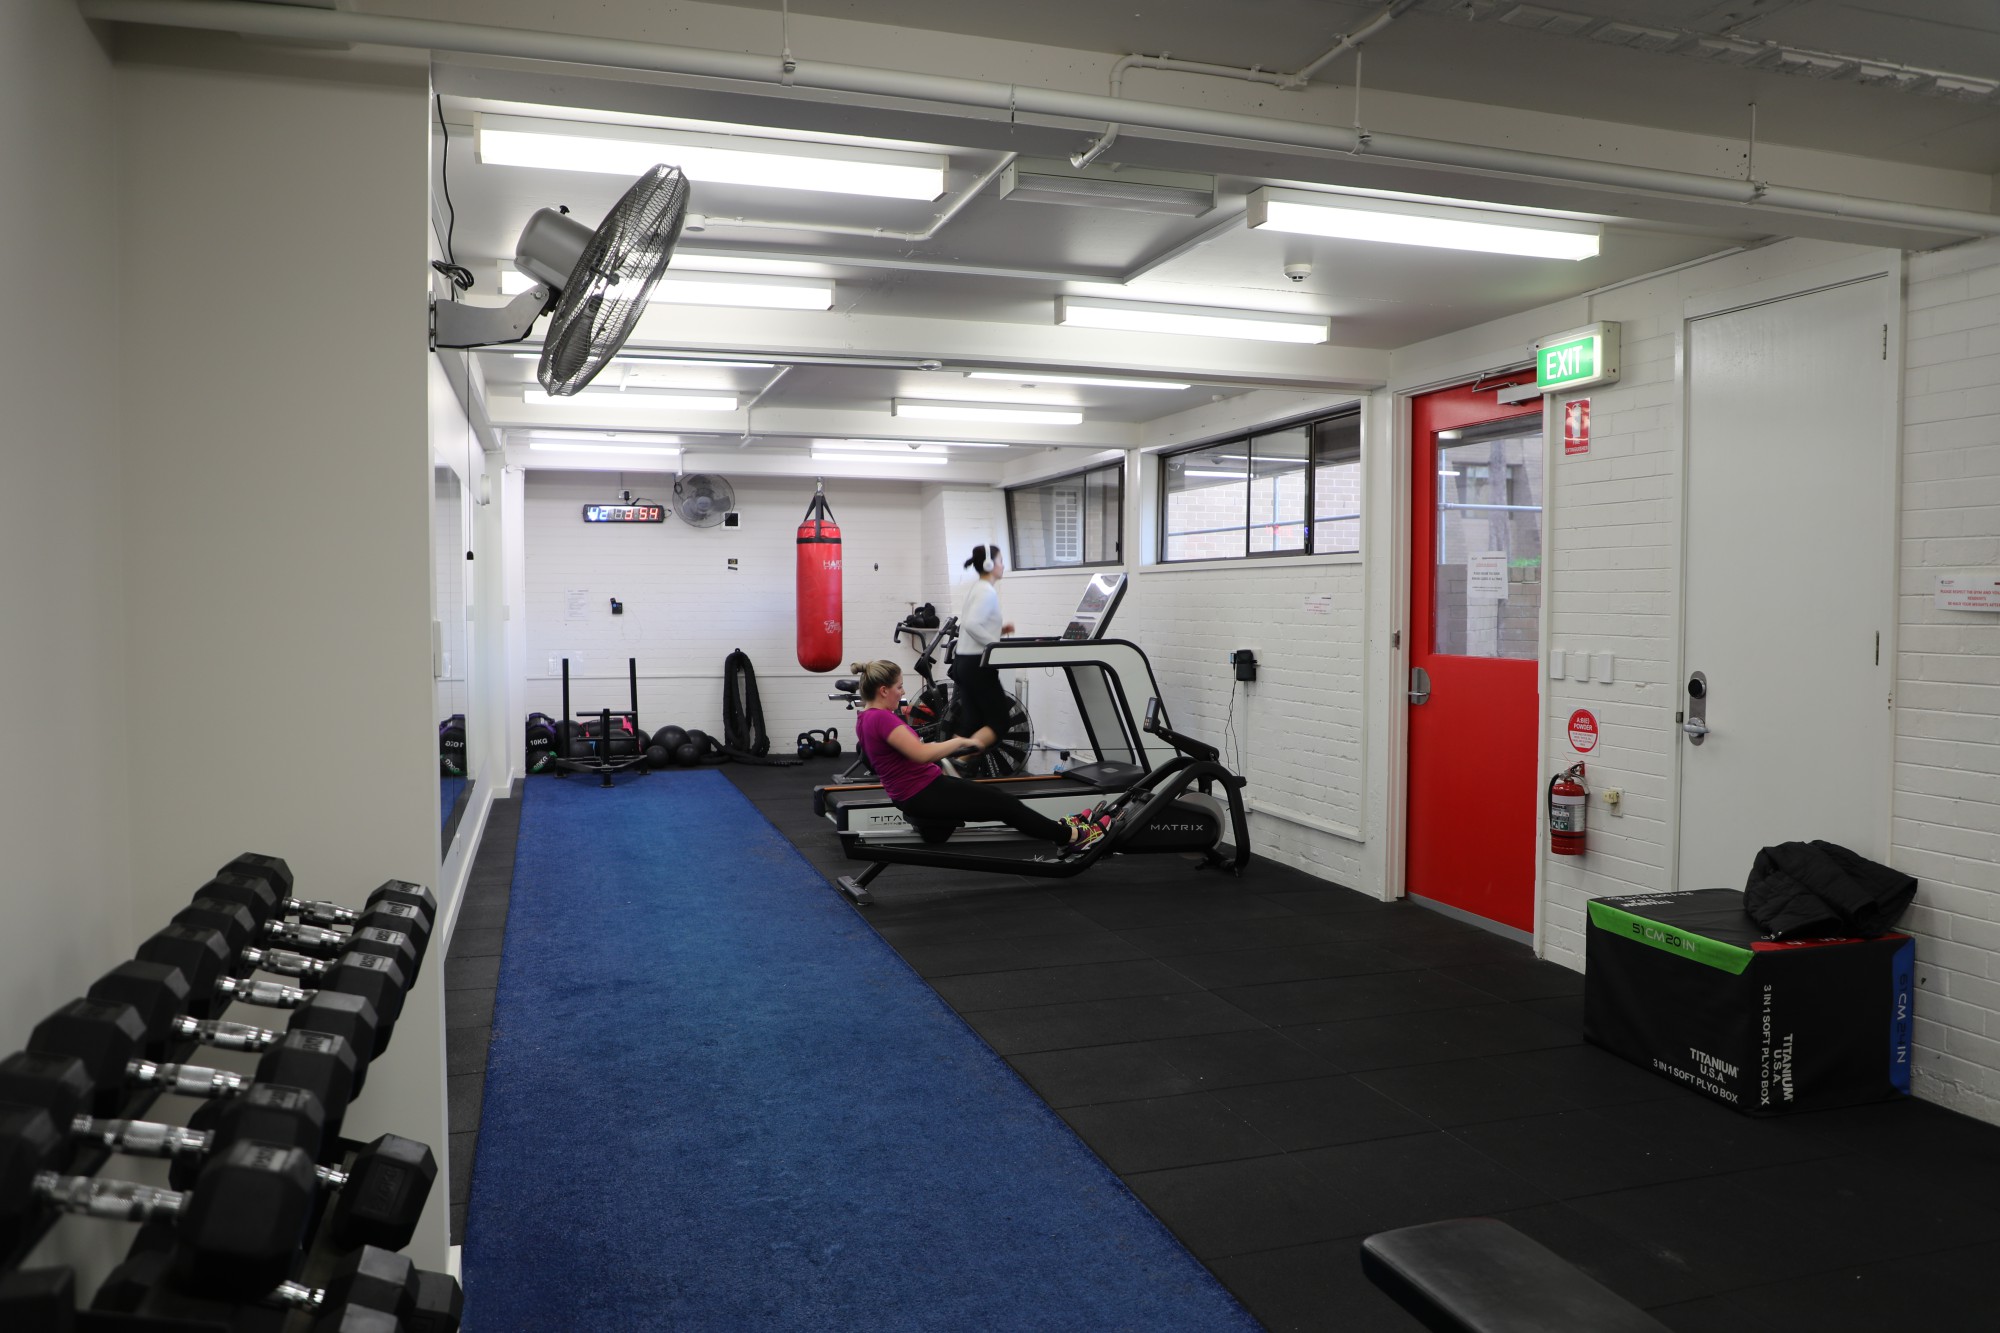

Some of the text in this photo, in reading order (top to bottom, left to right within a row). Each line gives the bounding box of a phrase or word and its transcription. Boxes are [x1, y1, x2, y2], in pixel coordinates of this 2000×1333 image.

[1546, 345, 1583, 380] EXIT
[1764, 994, 1771, 1005] IN
[1653, 1058, 1738, 1104] 3 IN 1 SOFT PLYO BOX
[1761, 1081, 1770, 1106] BOX
